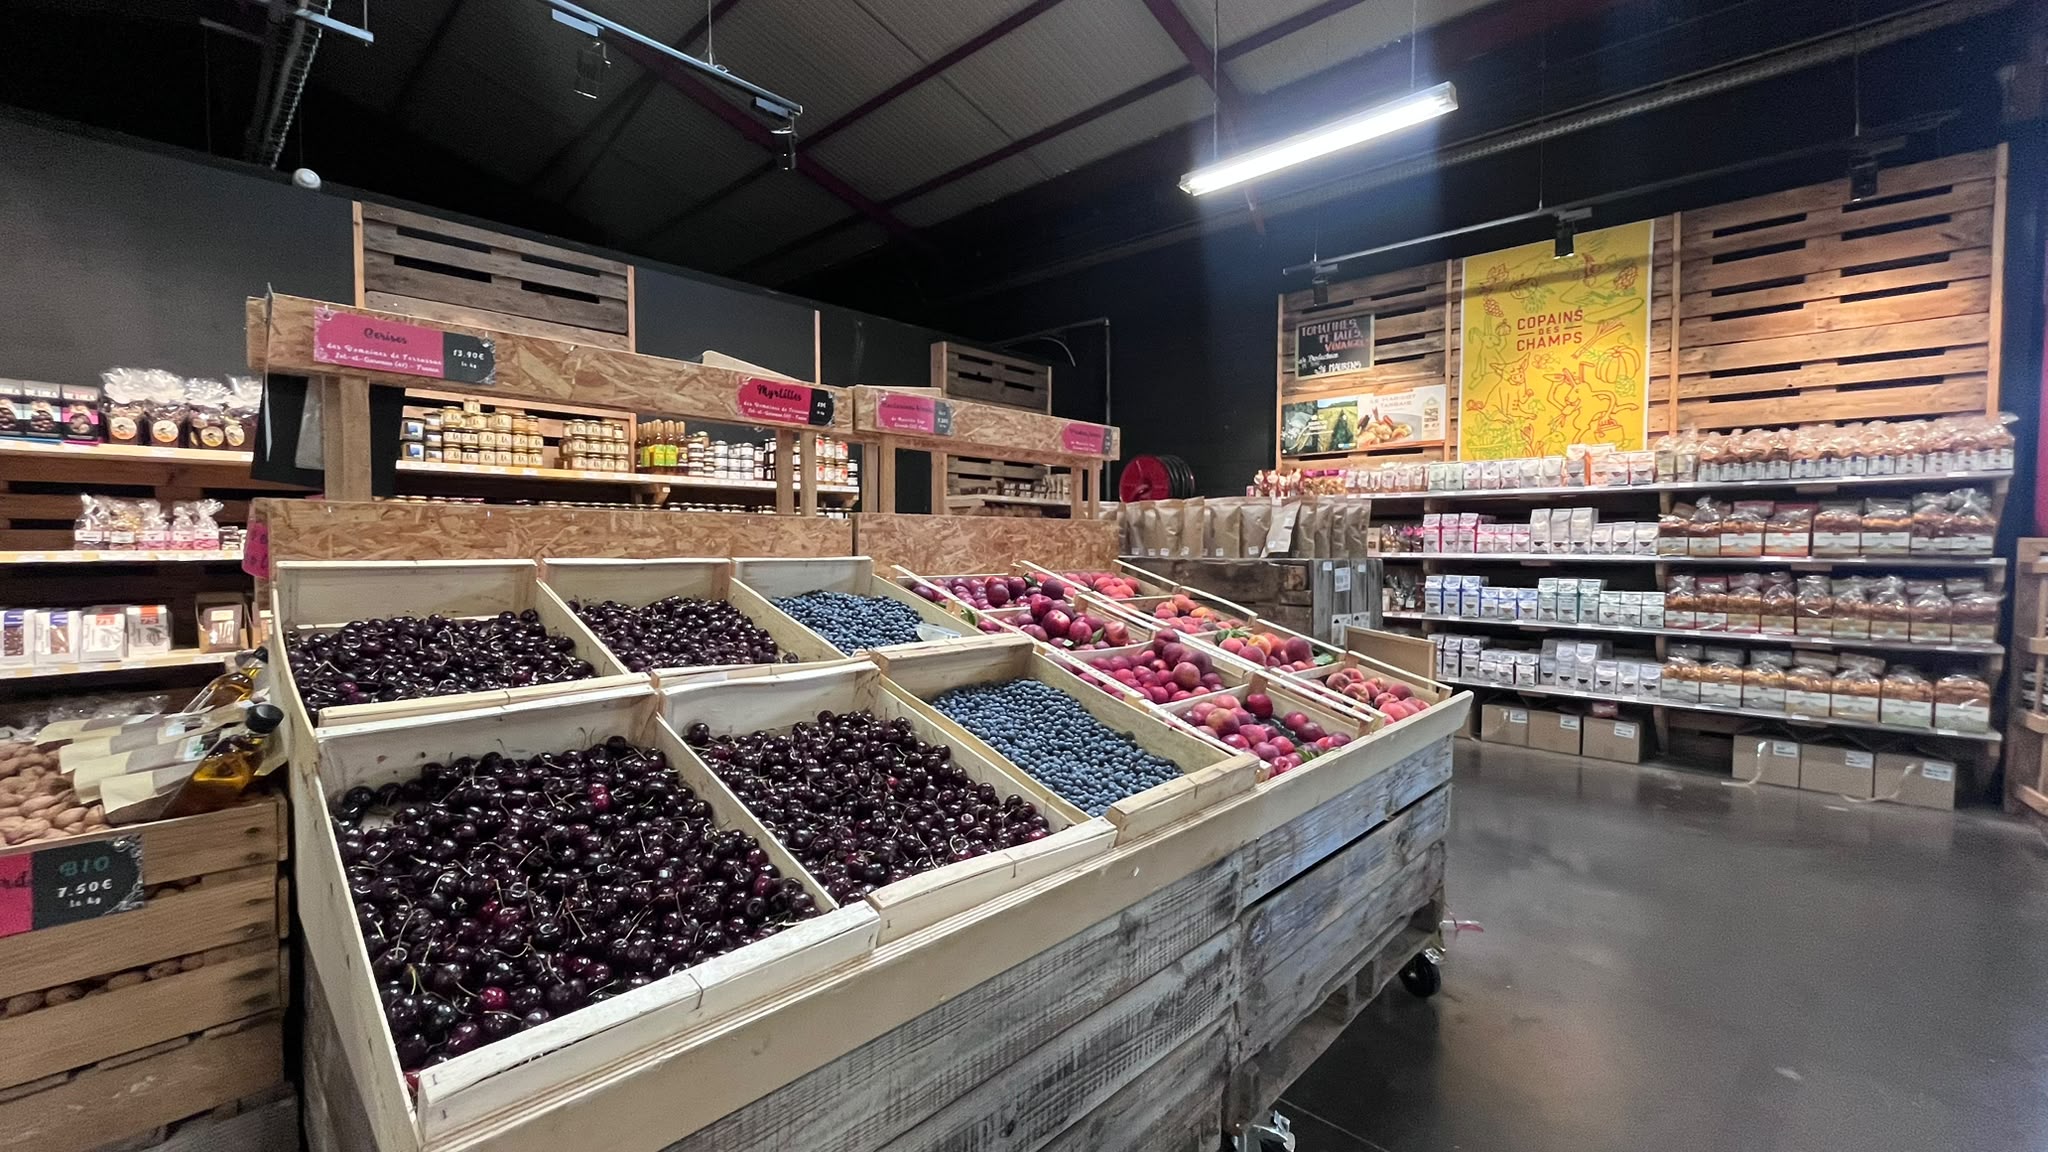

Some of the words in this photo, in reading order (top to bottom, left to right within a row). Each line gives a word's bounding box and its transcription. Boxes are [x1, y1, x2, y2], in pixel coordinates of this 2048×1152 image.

[1517, 308, 1584, 331] COPAINS
[364, 327, 408, 344] Cerises
[1538, 325, 1560, 336] DES
[1516, 331, 1583, 352] CHAMPS
[757, 384, 802, 401] Myrtilles
[59, 856, 110, 877] BIO
